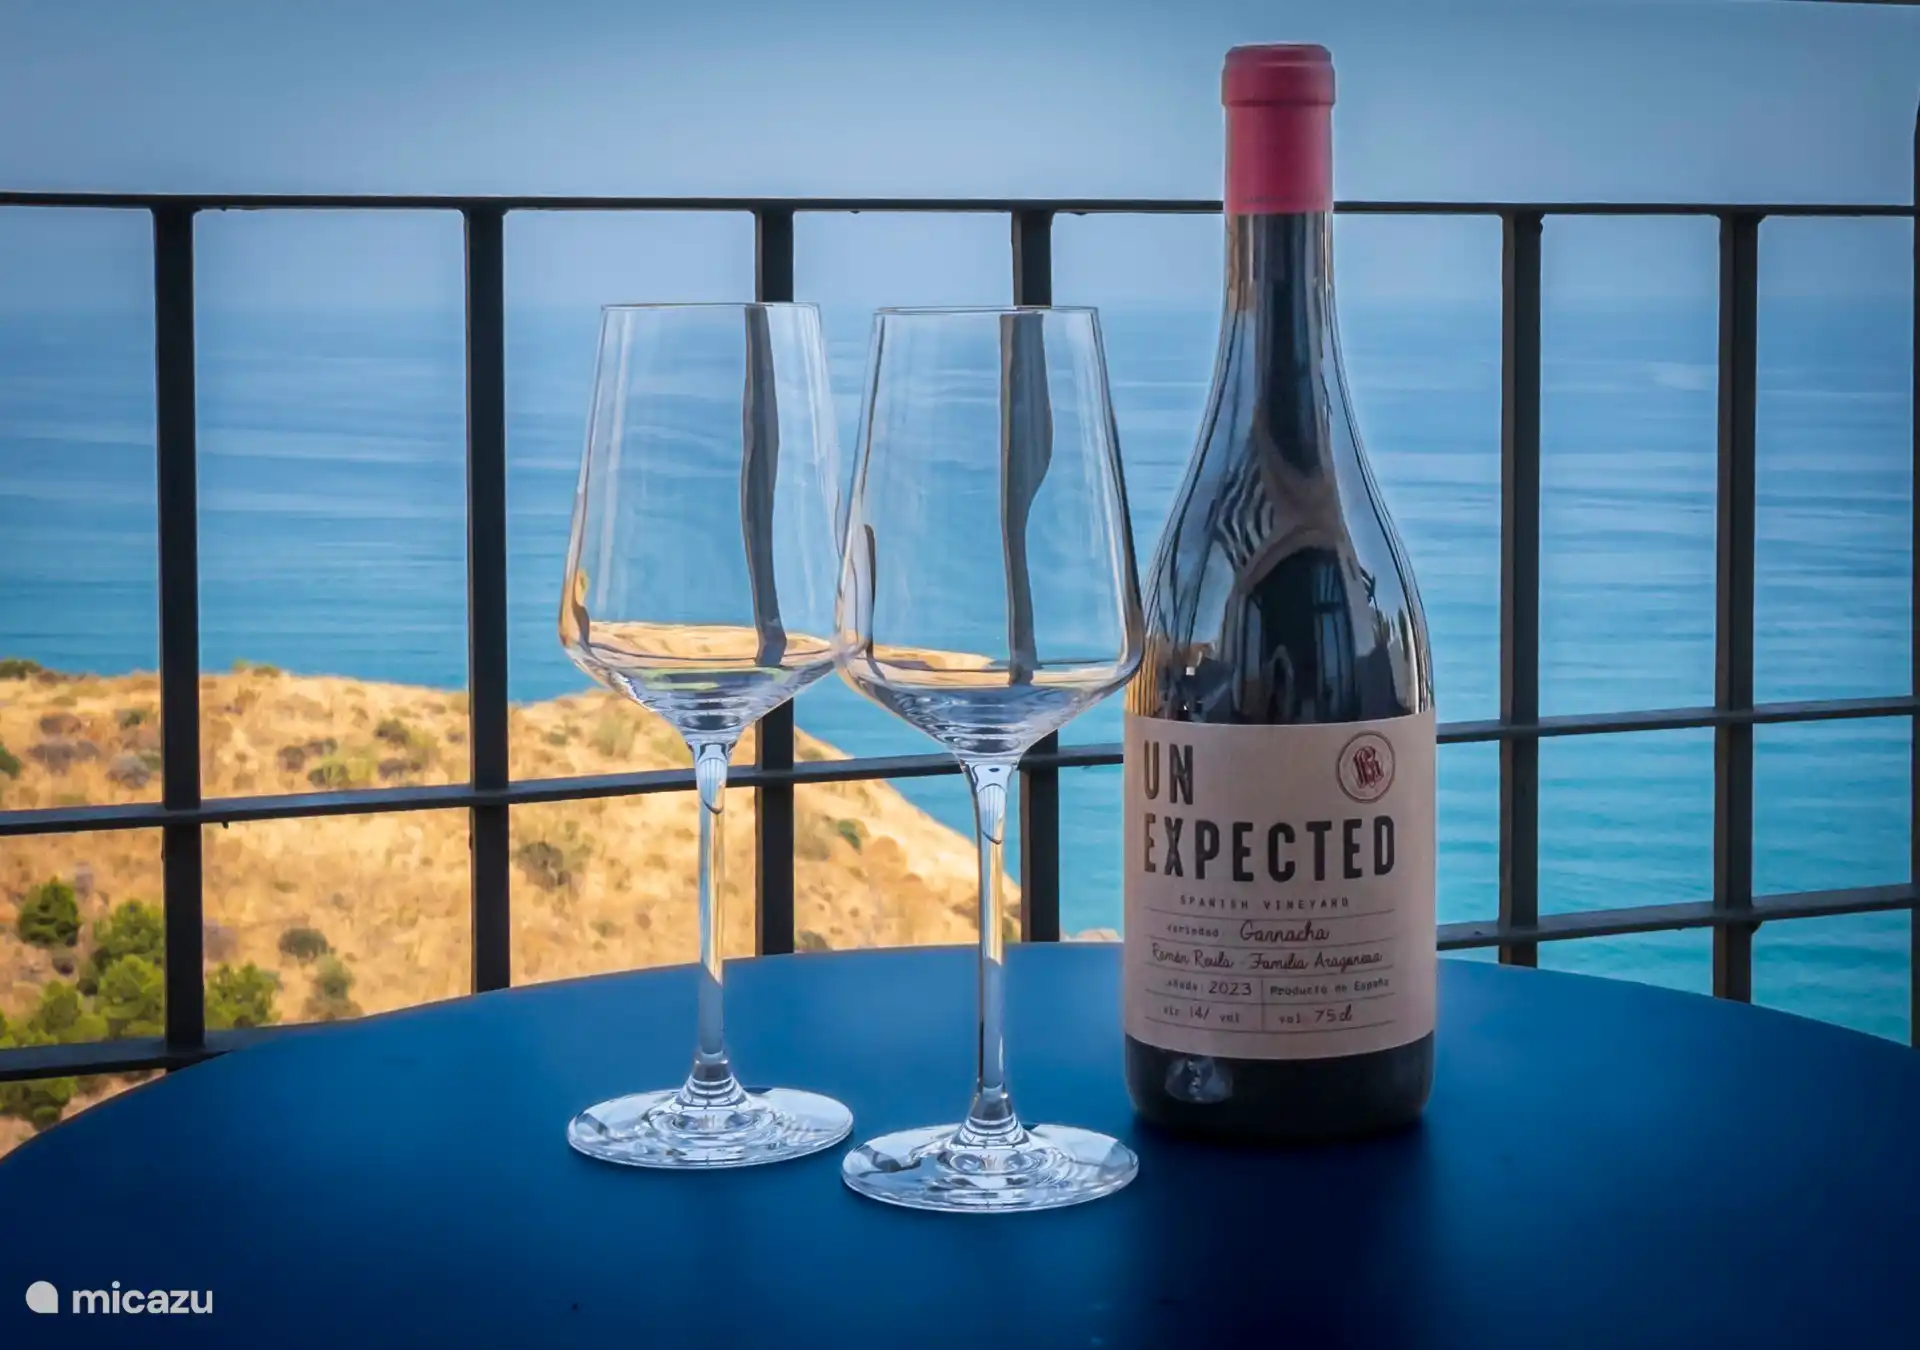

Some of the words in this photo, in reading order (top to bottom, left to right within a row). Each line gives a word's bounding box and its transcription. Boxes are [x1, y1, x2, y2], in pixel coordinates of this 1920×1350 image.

[1144, 740, 1194, 805] UN
[1144, 812, 1395, 883] EXPECTED
[1180, 895, 1248, 910] SPANISH
[1263, 896, 1349, 911] VINEYARD
[1240, 920, 1330, 943] Garnacha
[1248, 952, 1309, 970] Familia
[1208, 980, 1252, 996] 2023
